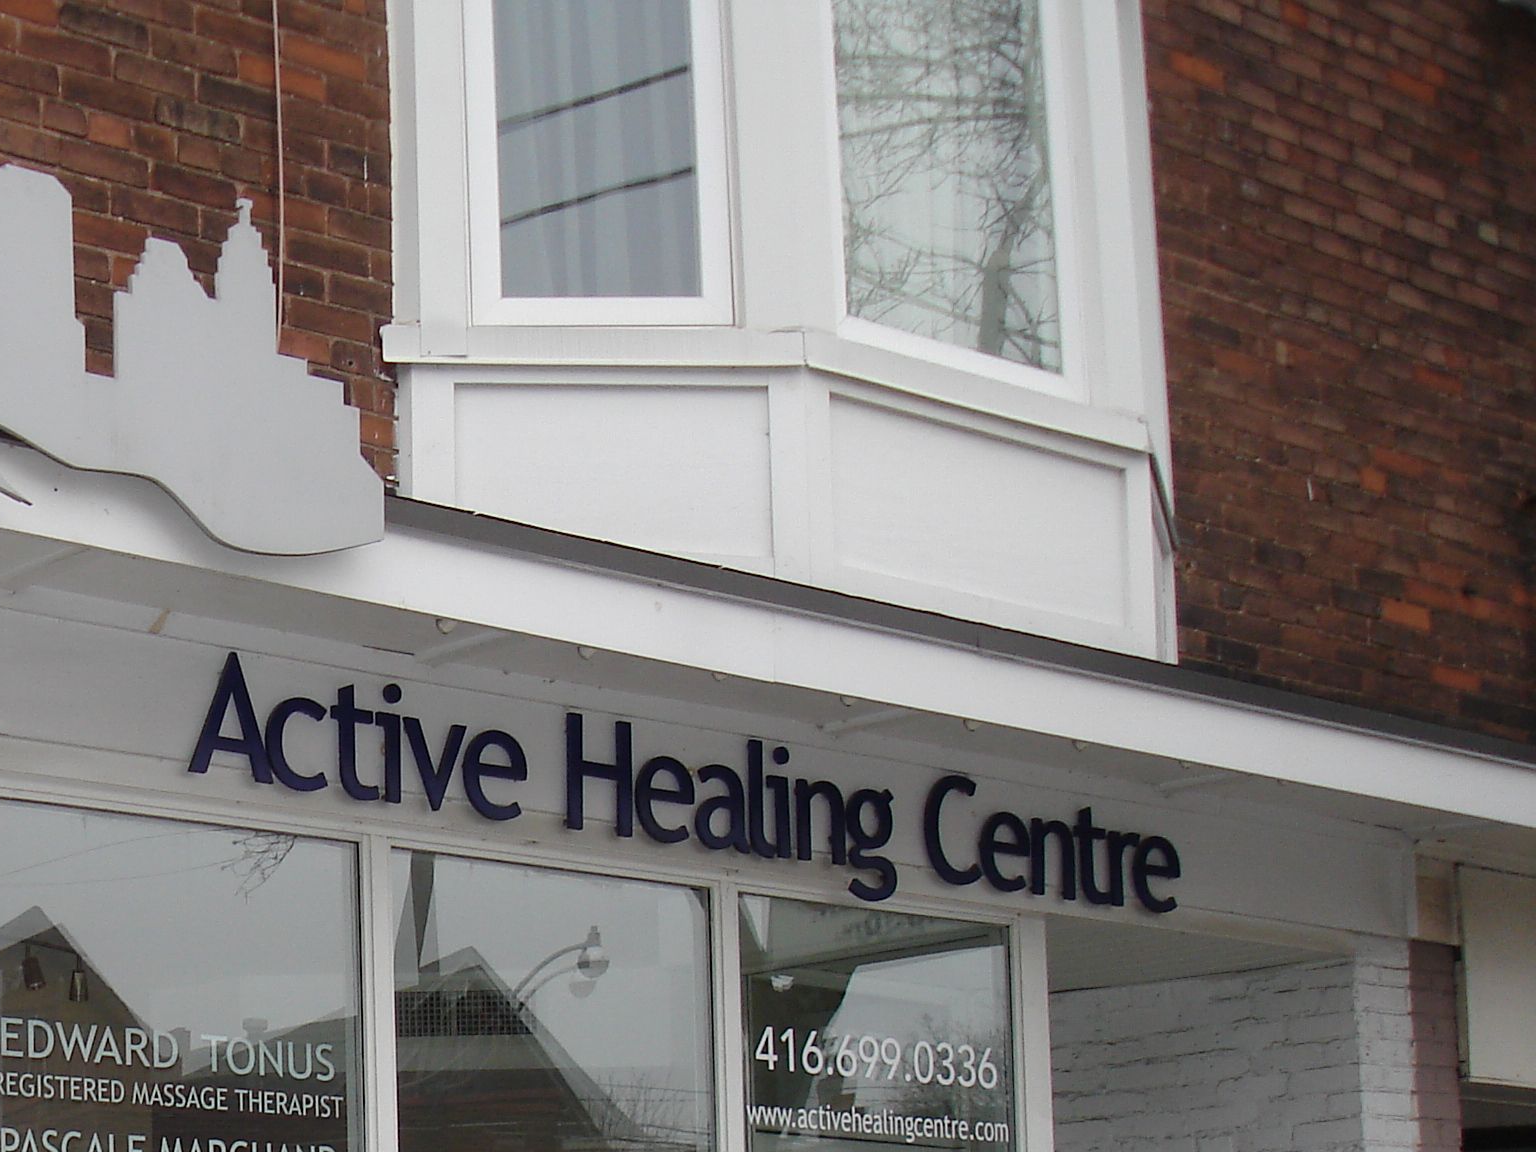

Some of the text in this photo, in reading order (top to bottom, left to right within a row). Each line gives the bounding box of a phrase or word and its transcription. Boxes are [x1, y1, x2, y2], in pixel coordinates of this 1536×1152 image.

[188, 651, 1182, 914] Active Healing Centre
[0, 1016, 336, 1082] EDWARD TONUS
[755, 1025, 998, 1090] 416.699.0336
[131, 1081, 229, 1112] MASSAGE
[234, 1088, 344, 1119] THERAPIST
[746, 1103, 1010, 1143] www.activehealingcentre.com
